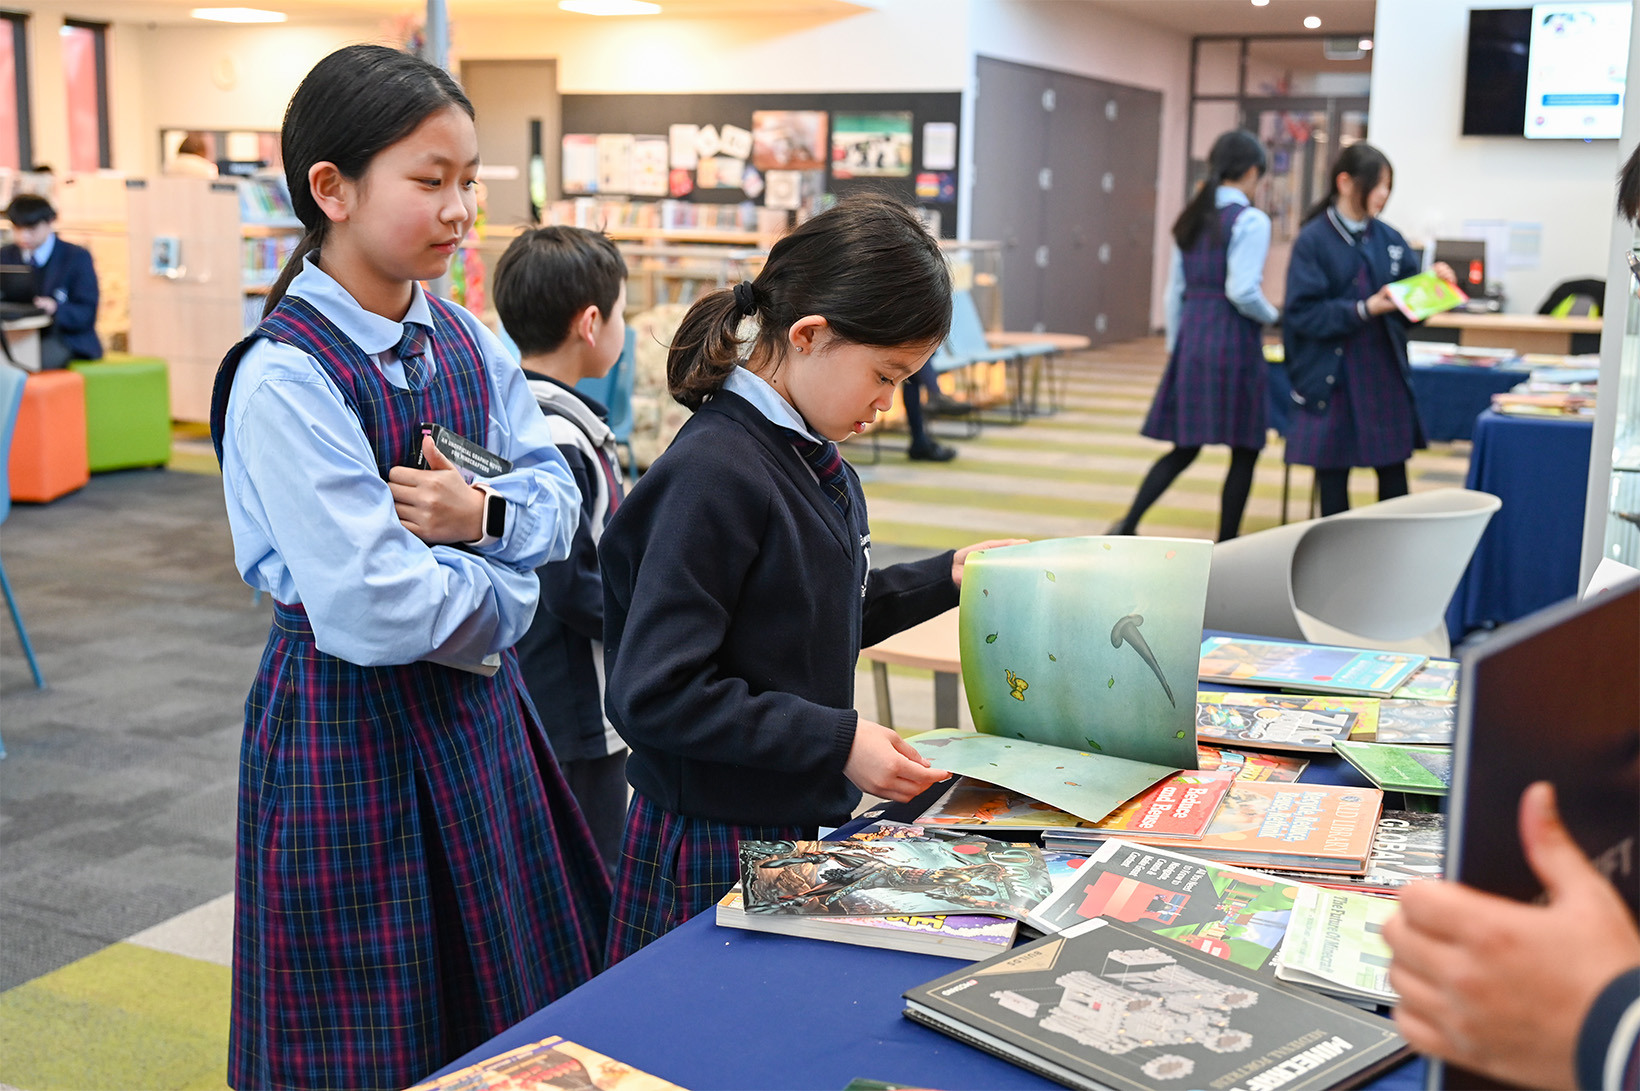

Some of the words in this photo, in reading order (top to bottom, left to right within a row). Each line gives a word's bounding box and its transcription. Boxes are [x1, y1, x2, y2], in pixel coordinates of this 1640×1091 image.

[472, 452, 490, 466] GRAPHIC
[1155, 786, 1177, 803] and
[1172, 787, 1209, 818] Reduce
[1138, 803, 1173, 829] Reuse
[1323, 819, 1357, 854] LIBRARY
[1369, 818, 1410, 868] GLOBAL
[1332, 895, 1349, 909] The
[1326, 908, 1346, 932] Future
[1007, 950, 1043, 967] BUILDS
[1318, 939, 1340, 974] Minecraft
[1267, 1028, 1328, 1060] MEDIEVAL
